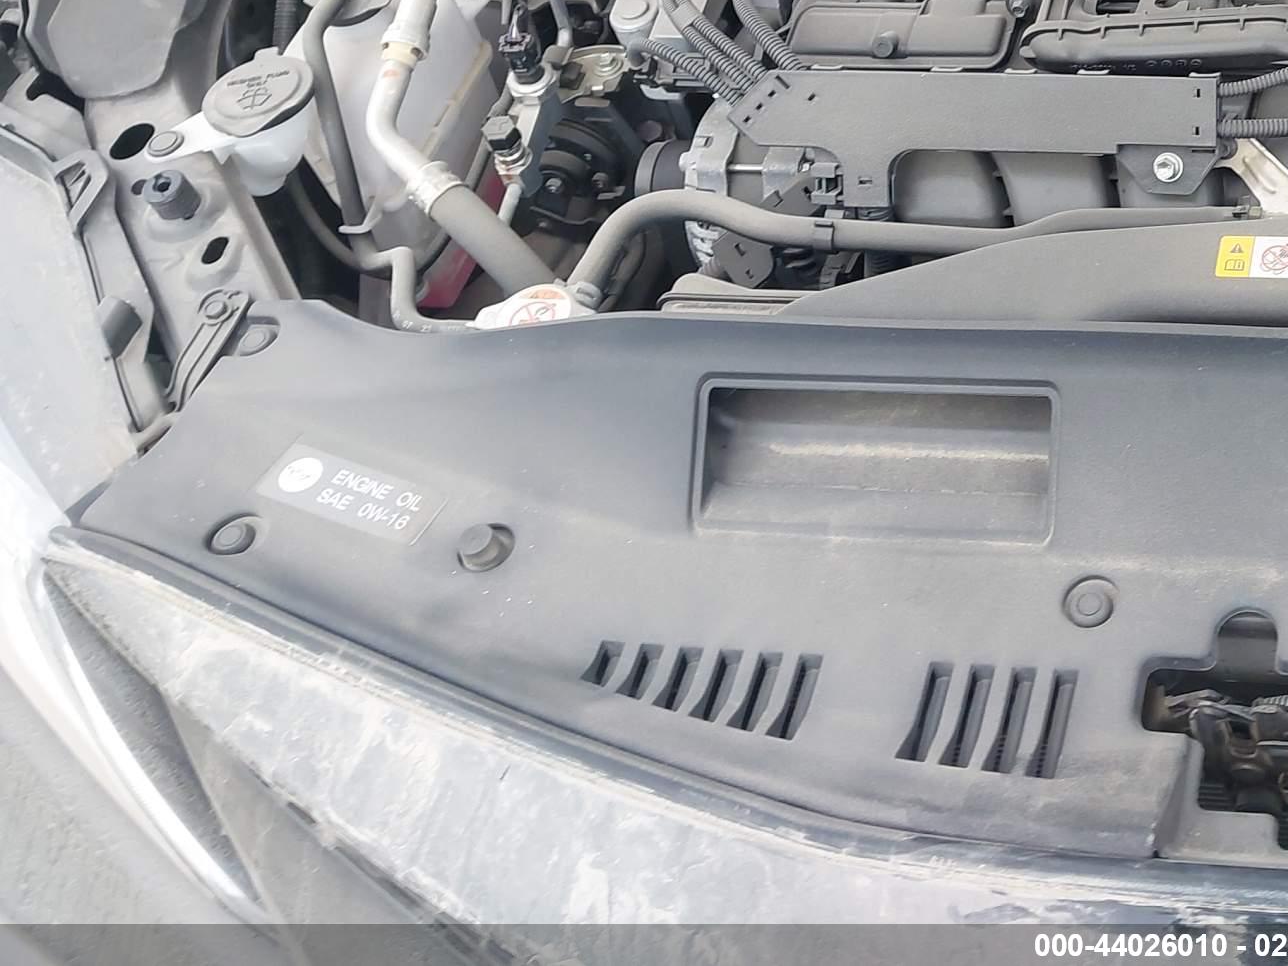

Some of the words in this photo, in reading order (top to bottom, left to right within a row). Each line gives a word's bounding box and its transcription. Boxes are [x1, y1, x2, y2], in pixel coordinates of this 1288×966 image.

[316, 488, 355, 511] SAE
[357, 502, 410, 530] 0W-16
[331, 469, 395, 500] ENGINE
[396, 491, 422, 512] OIL
